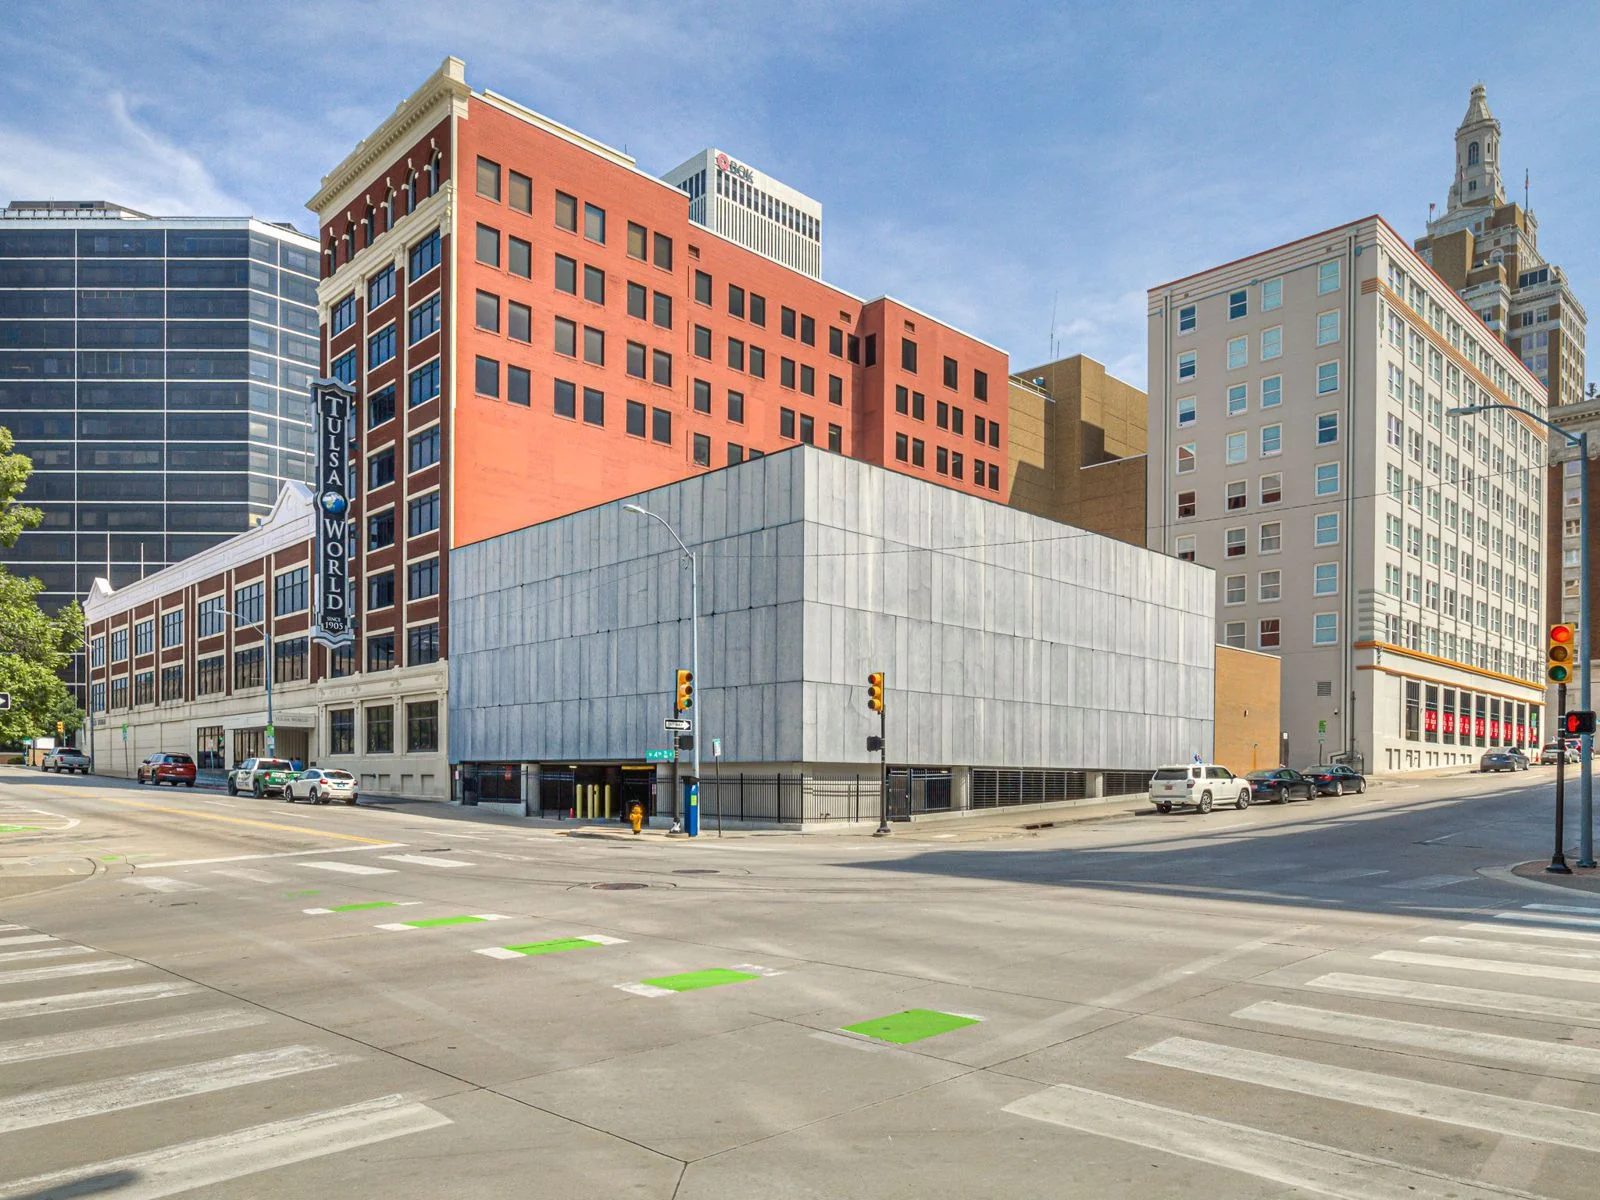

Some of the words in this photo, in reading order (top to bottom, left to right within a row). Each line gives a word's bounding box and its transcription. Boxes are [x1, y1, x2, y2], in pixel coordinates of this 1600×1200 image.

[325, 395, 343, 486] TULSA
[324, 518, 345, 610] WORLD
[325, 621, 344, 630] 1905
